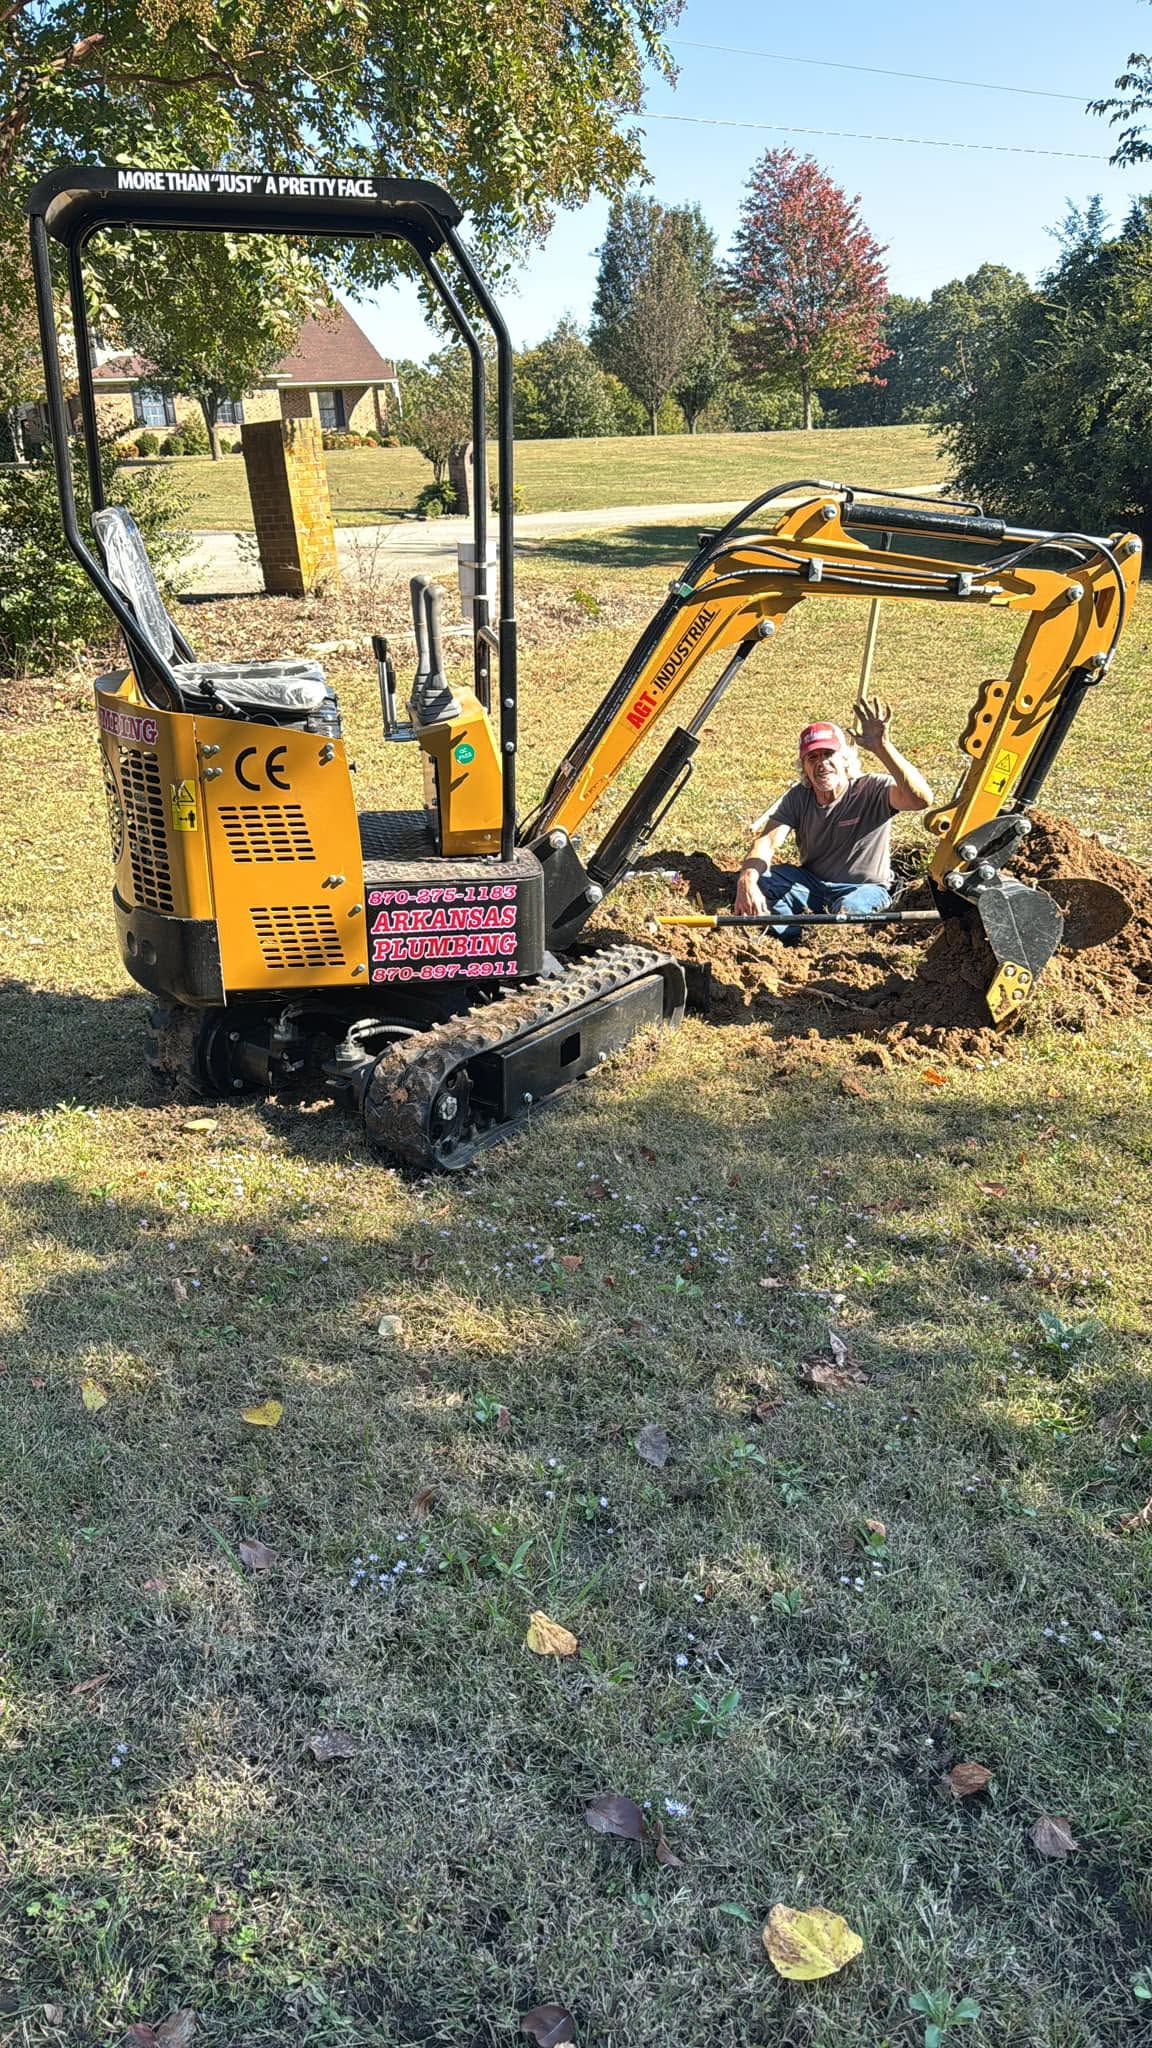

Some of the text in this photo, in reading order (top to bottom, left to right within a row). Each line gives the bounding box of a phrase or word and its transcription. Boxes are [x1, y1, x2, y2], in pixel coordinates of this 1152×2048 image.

[118, 170, 165, 190] MORE
[165, 172, 211, 192] THAN
[265, 176, 277, 194] A
[278, 176, 336, 196] PRETTY
[338, 179, 378, 198] FACE.
[626, 608, 716, 729] AGT INDUSTRIAL
[235, 746, 291, 791] CE
[368, 885, 517, 905] 870-275-1183
[371, 906, 517, 934] ARKANSAS
[372, 932, 517, 961] PLUMBING
[372, 961, 518, 983] 870-897-2911
